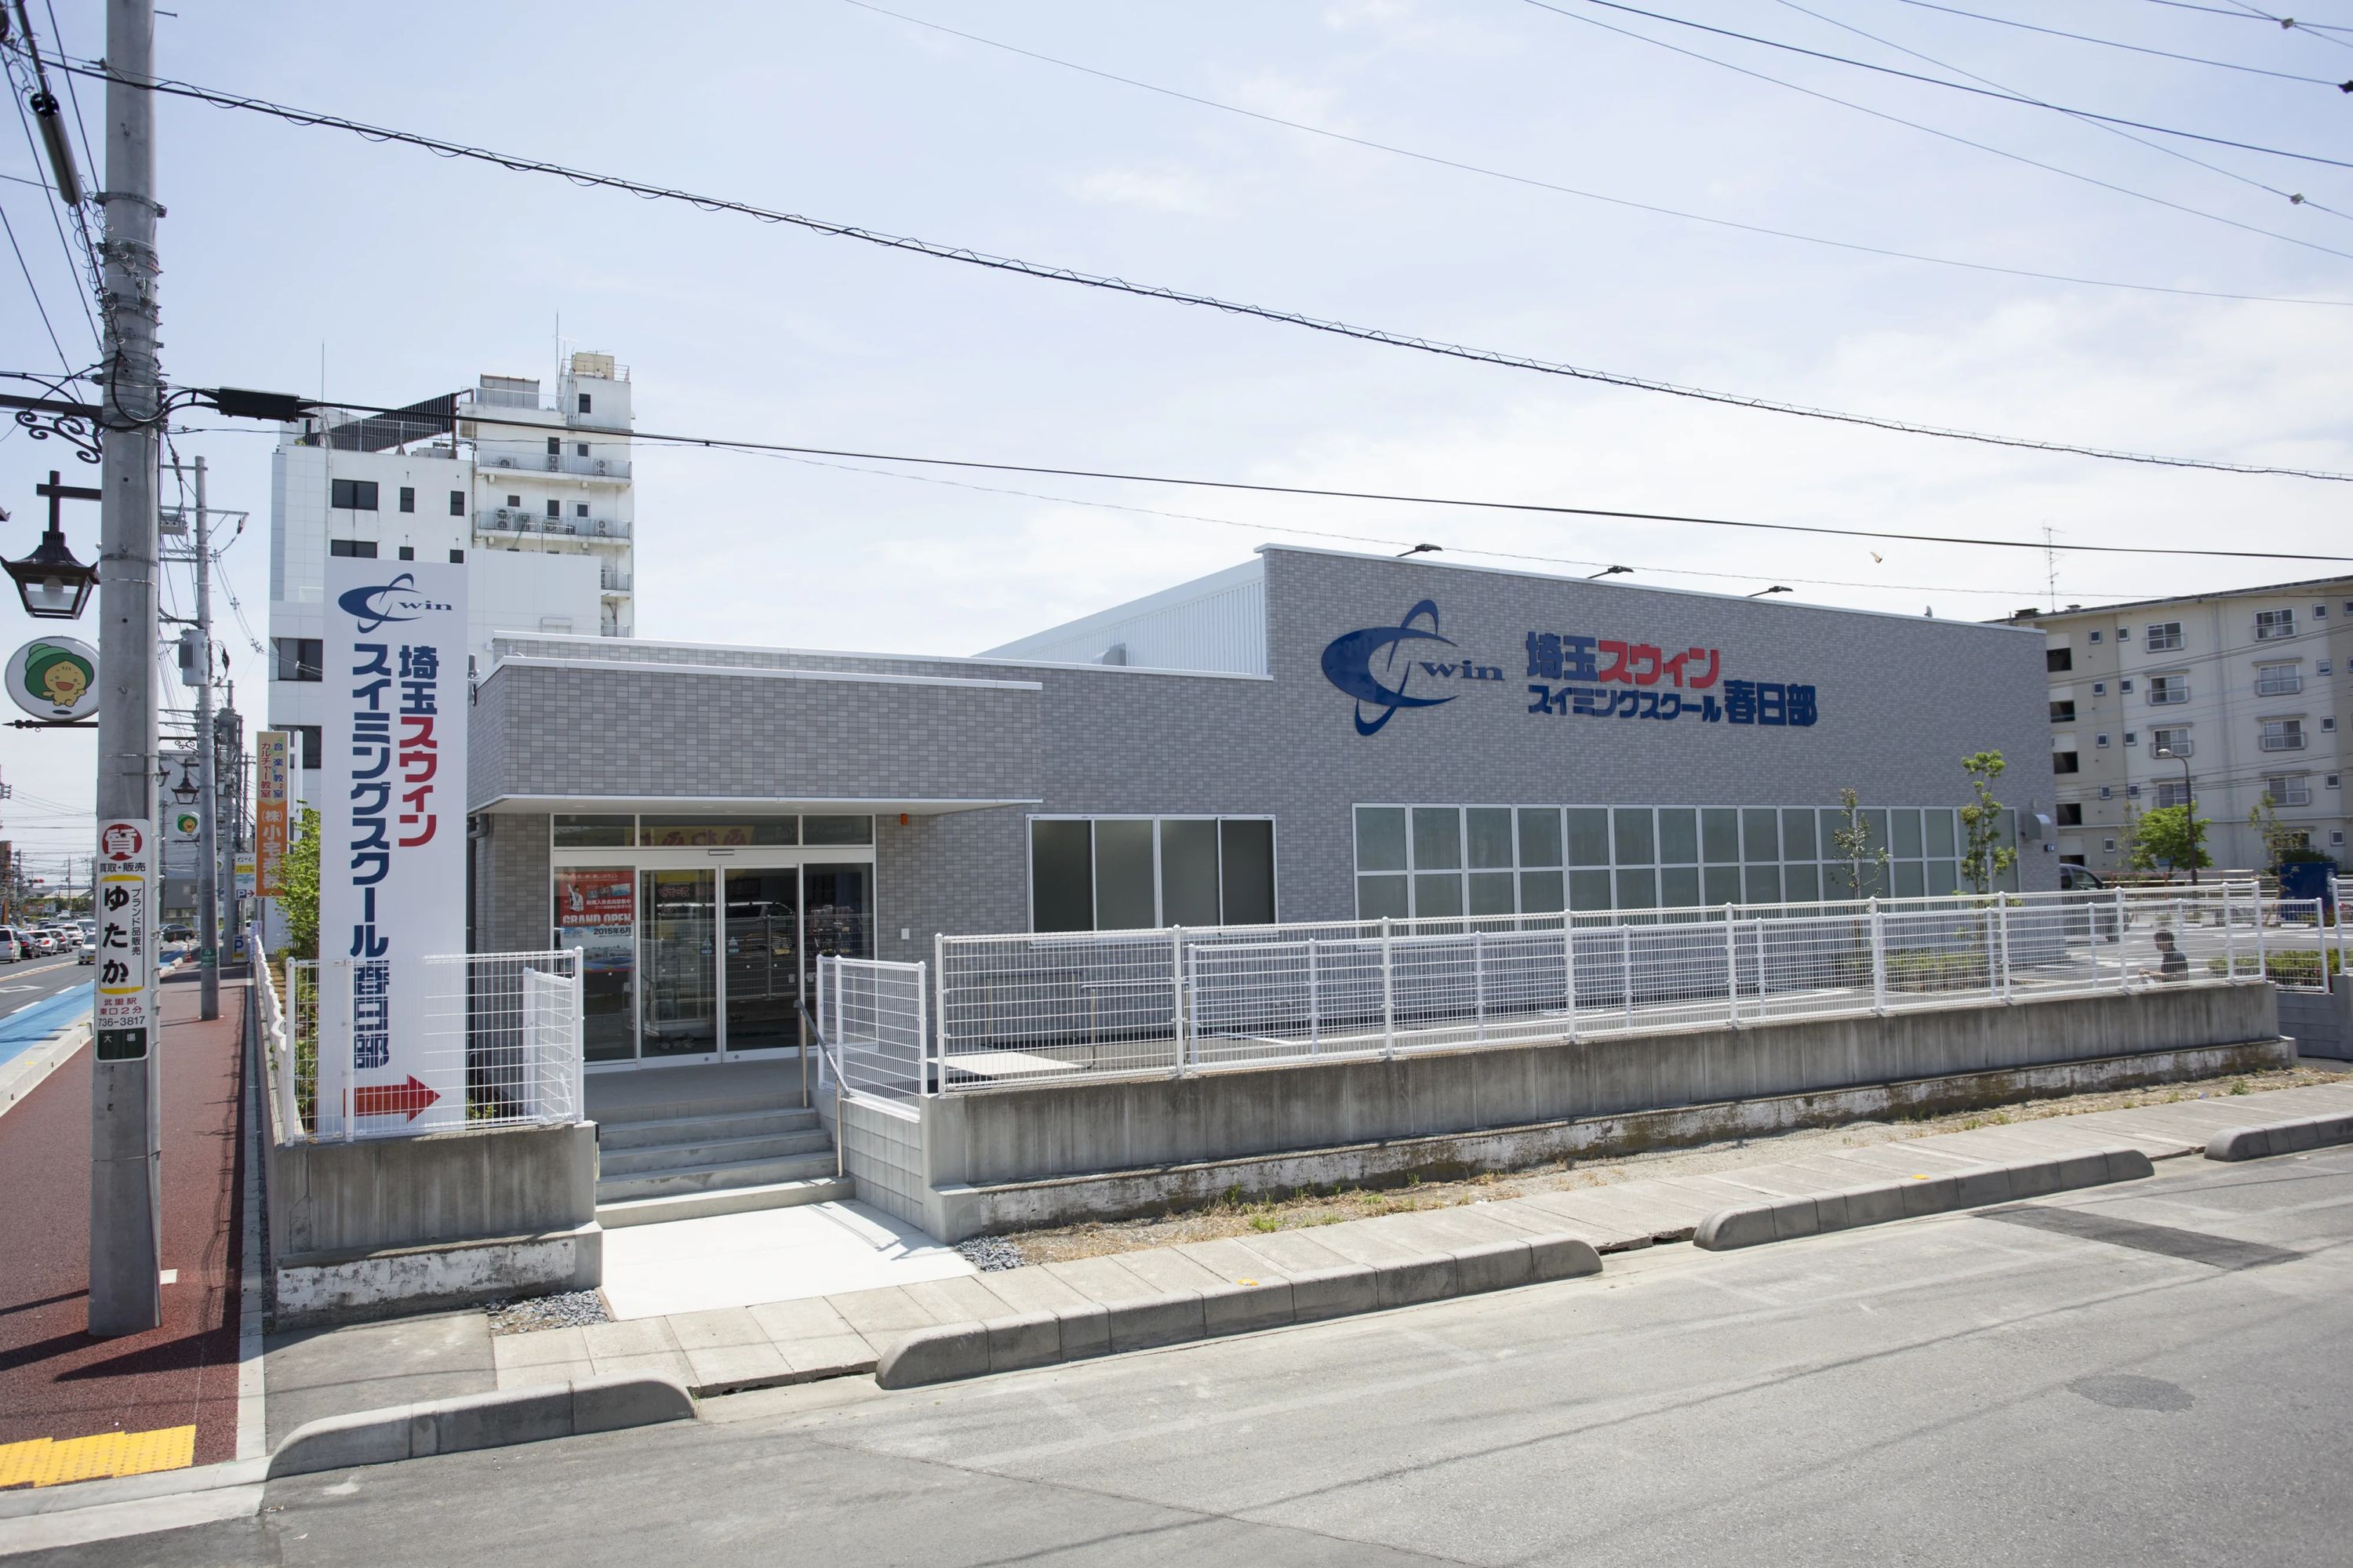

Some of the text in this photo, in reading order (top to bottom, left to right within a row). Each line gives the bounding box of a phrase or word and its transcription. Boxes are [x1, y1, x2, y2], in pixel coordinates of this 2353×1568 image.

[1526, 631, 1719, 689] 埼玉スウィン
[1528, 679, 1817, 726] スイミングスクール春日部
[260, 743, 271, 798] カルチャー教室
[274, 743, 283, 798] 音楽教室
[398, 645, 439, 847] 埼玉スウィン
[100, 862, 146, 873] 買取・販売
[101, 886, 129, 984] ゆたか
[132, 888, 141, 955] ブランド品販売
[562, 914, 602, 926] GRAND
[98, 1017, 145, 1027] 736-3817
